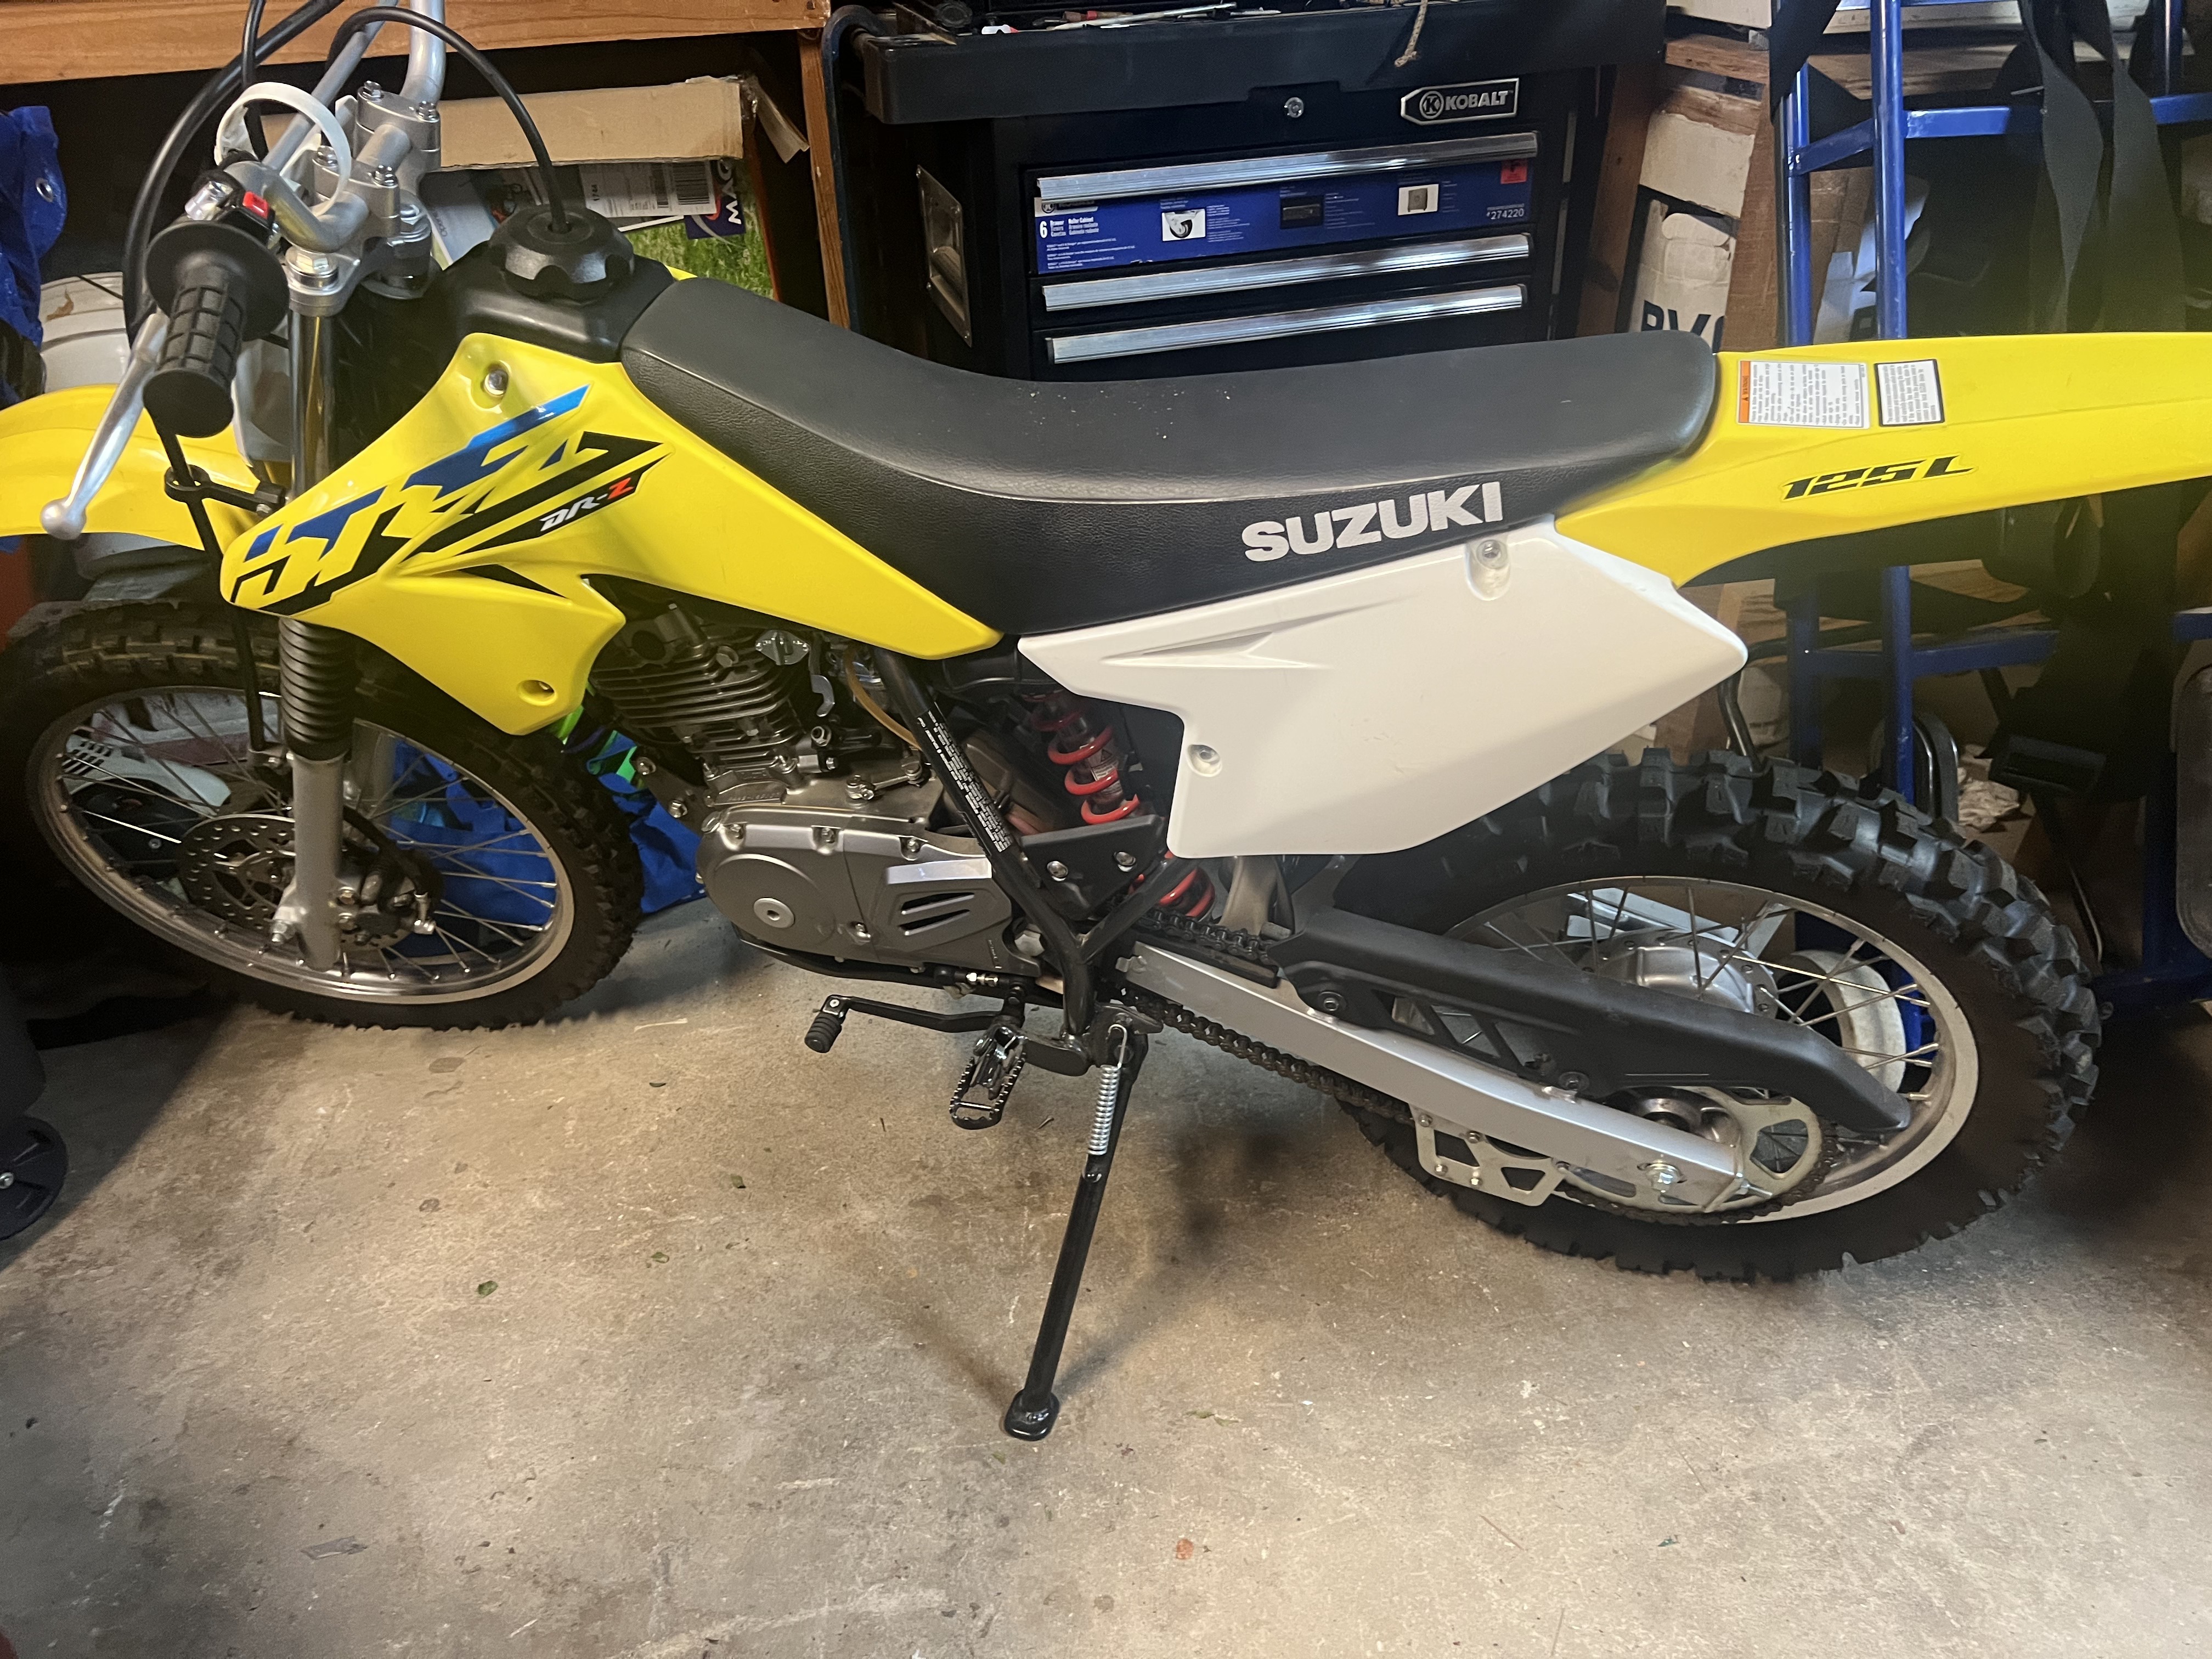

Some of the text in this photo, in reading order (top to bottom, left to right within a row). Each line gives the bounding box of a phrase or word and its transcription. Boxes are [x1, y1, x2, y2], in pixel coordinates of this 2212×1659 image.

[1445, 91, 1509, 110] KOBALT
[1039, 221, 1048, 239] 6
[539, 477, 635, 532] DR-Z
[1241, 481, 1503, 562] SUZUKI
